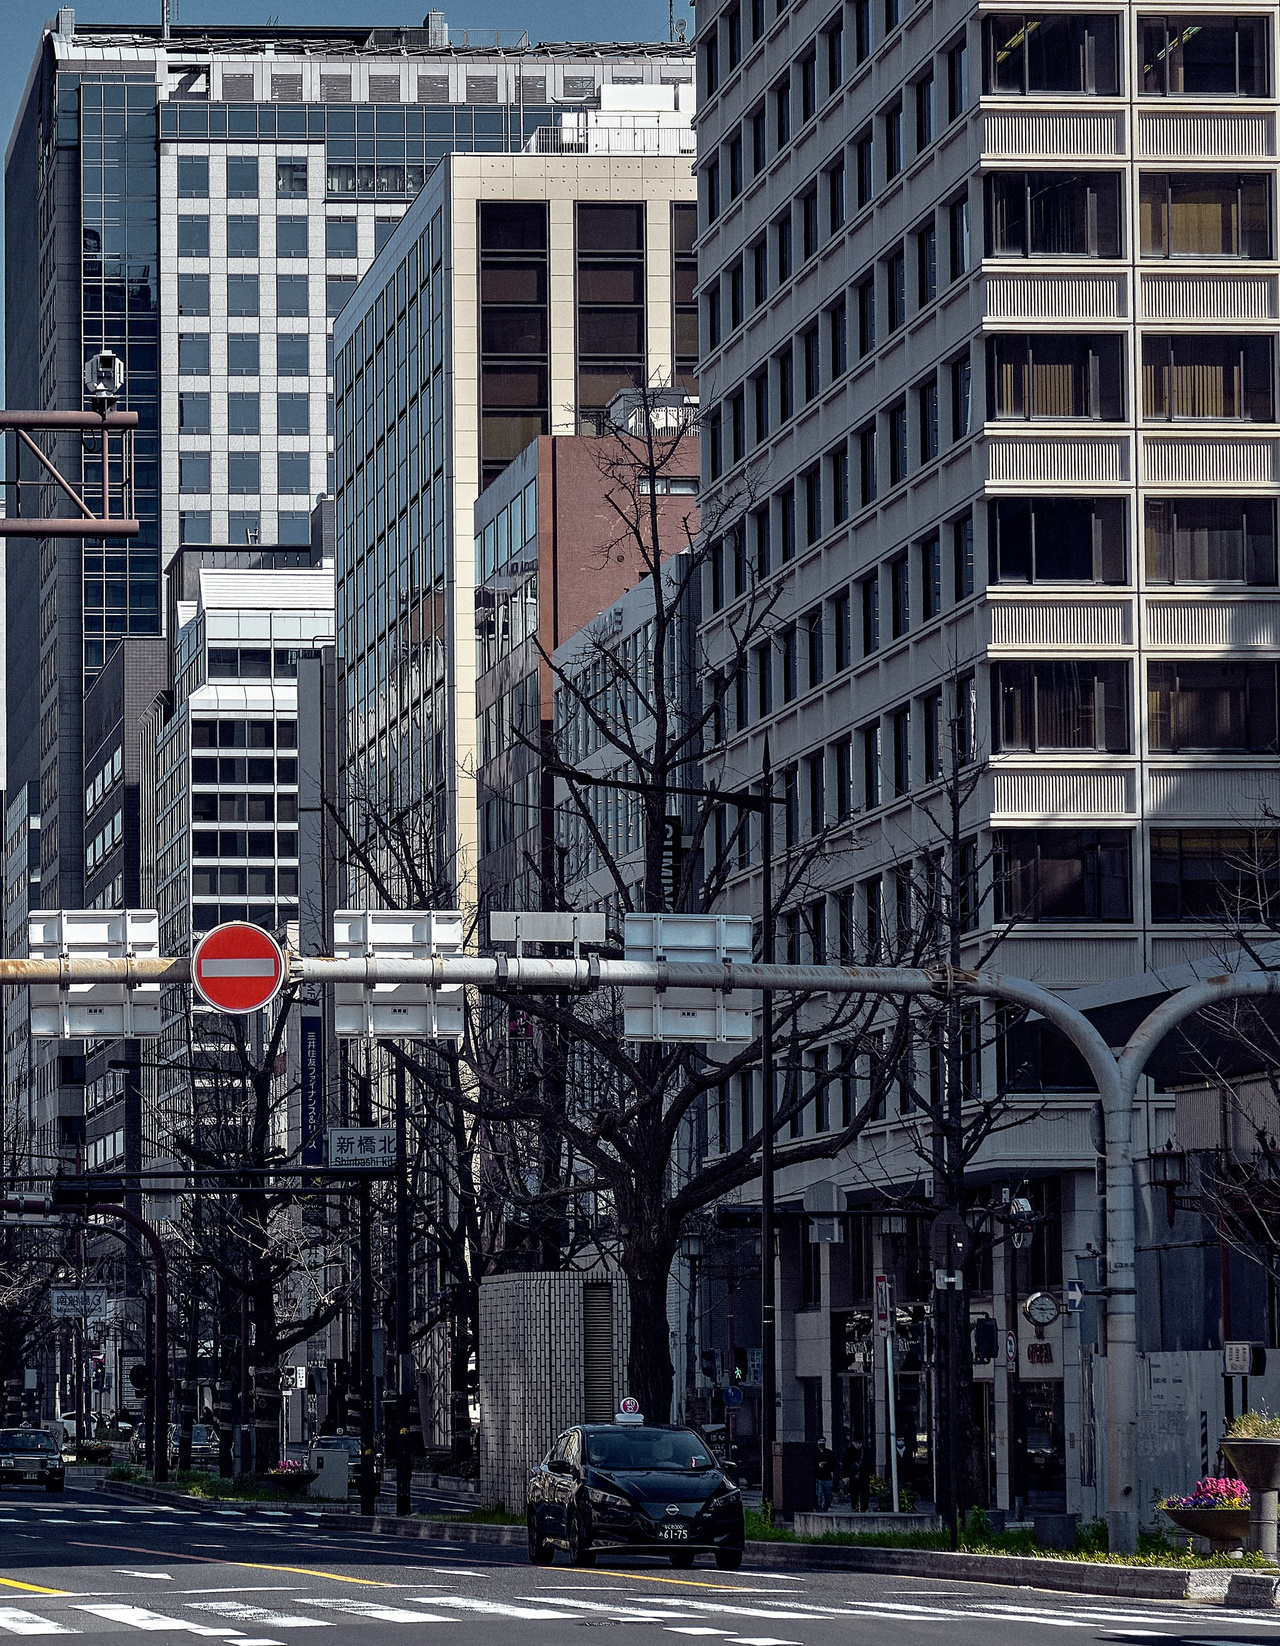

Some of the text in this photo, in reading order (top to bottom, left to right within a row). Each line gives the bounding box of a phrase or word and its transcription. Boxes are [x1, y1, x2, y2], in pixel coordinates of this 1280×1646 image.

[336, 1135, 397, 1155] 新橋北
[334, 1156, 379, 1167] Shinbashi
